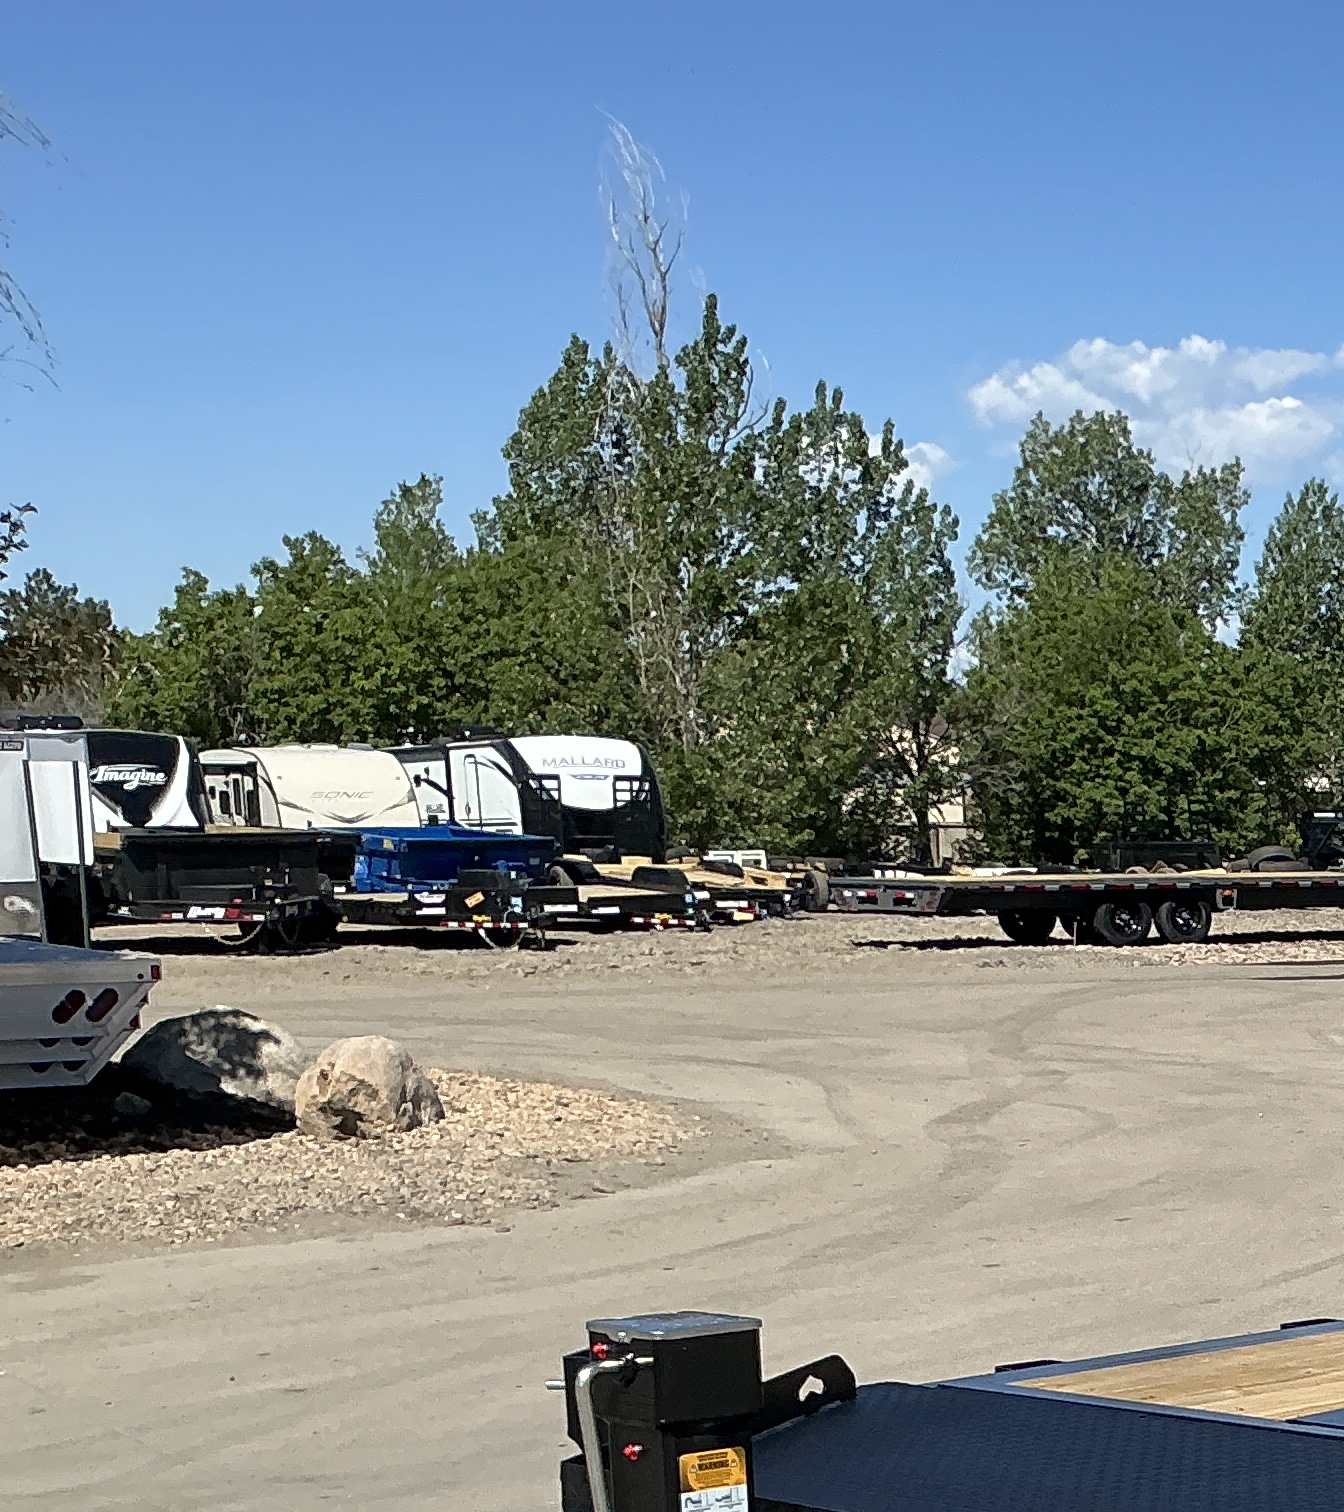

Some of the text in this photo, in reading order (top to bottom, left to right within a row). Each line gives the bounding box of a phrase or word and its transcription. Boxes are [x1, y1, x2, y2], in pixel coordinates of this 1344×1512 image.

[541, 756, 626, 769] MALLARD
[91, 765, 168, 790] Imagine
[310, 791, 375, 799] SONIC
